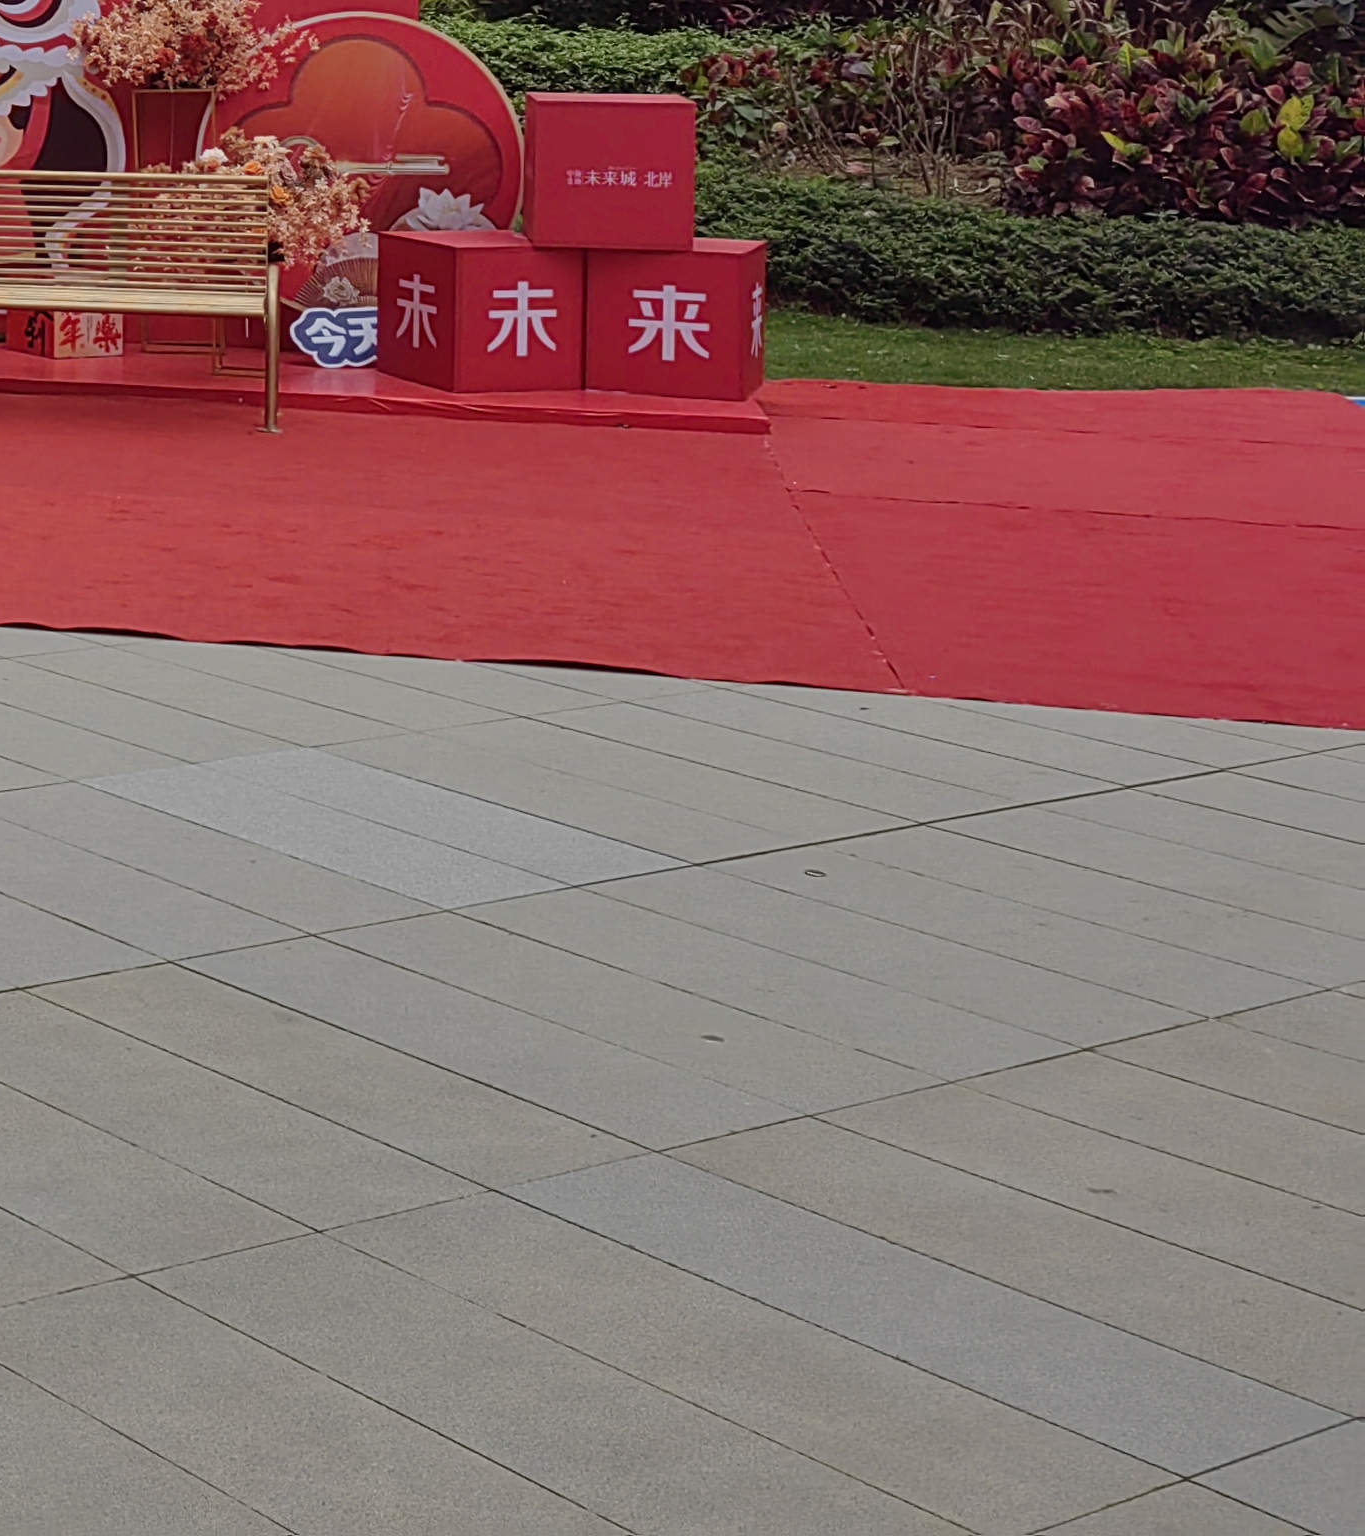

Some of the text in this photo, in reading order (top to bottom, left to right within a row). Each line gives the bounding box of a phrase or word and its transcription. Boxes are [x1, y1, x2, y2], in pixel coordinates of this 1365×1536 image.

[396, 274, 438, 349] 未
[487, 281, 710, 361] 未 来
